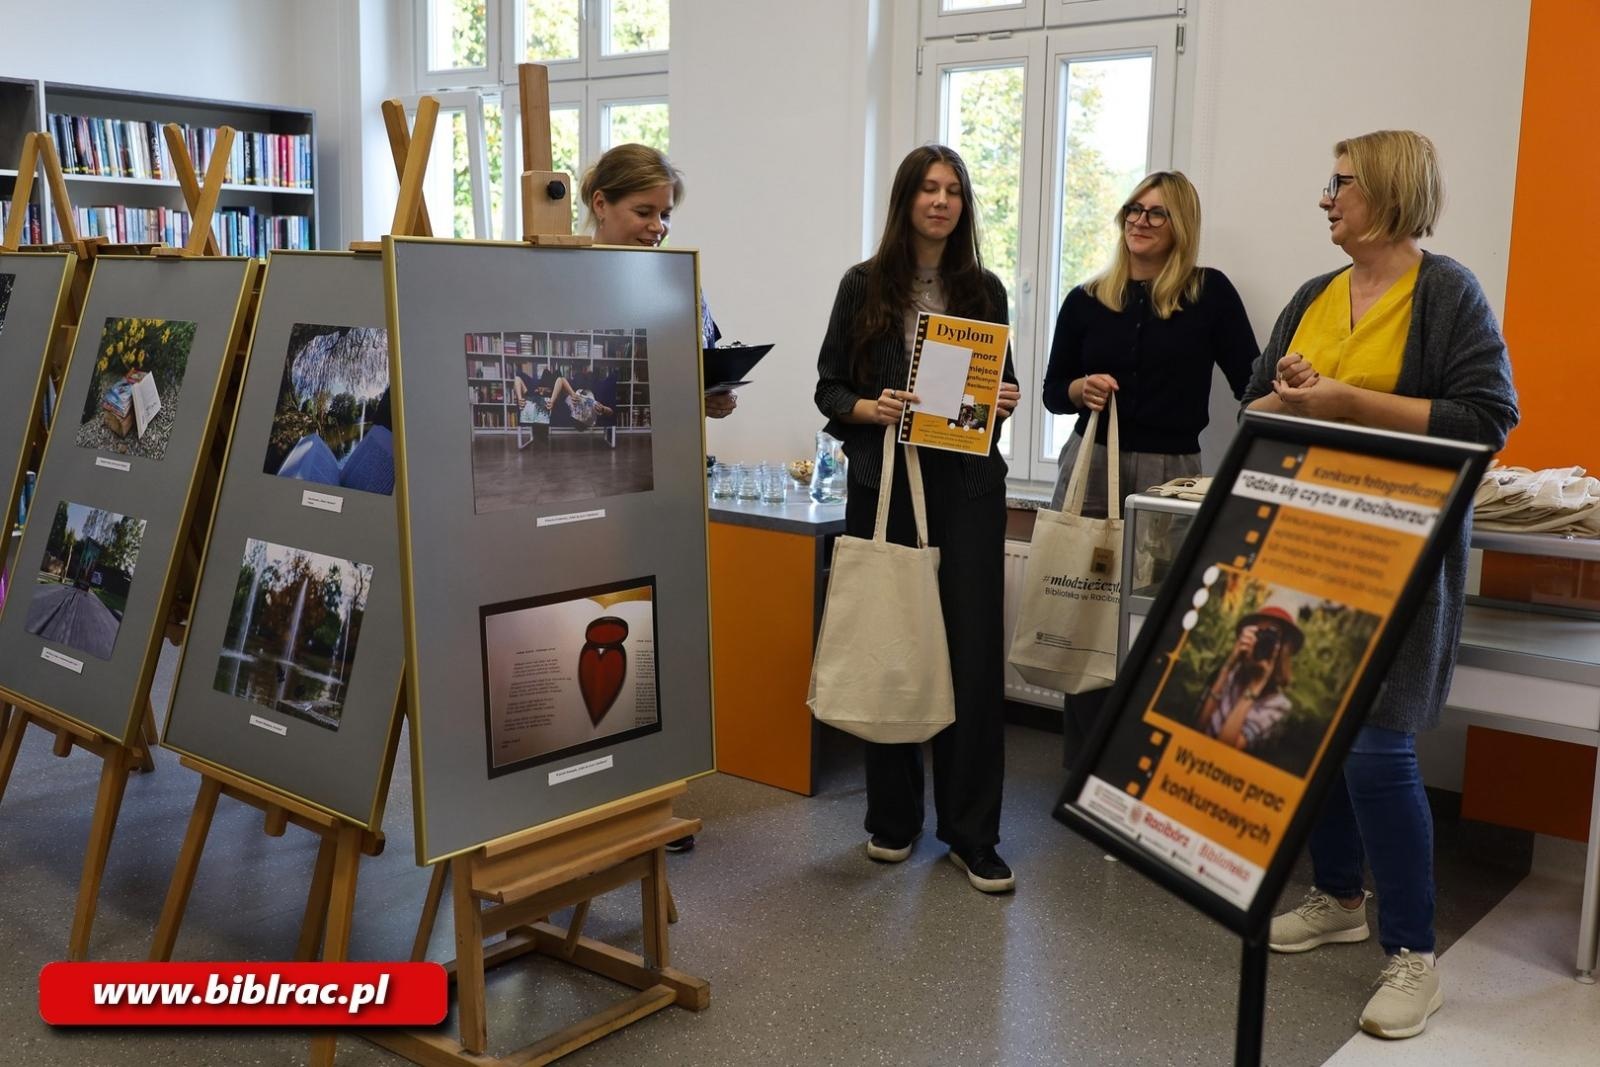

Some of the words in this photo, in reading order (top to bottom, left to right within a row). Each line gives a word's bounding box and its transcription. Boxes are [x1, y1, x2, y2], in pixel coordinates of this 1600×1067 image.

[937, 323, 994, 344] Dyplom
[1313, 466, 1361, 487] Konkurs
[1280, 485, 1298, 501] się
[1299, 490, 1337, 507] czyta
[1339, 496, 1351, 507] w
[1045, 587, 1080, 600] Biblioteka
[1081, 592, 1089, 601] w
[1175, 746, 1243, 792] Wystawa
[1244, 781, 1286, 812] prac
[1160, 775, 1272, 846] konkursowych
